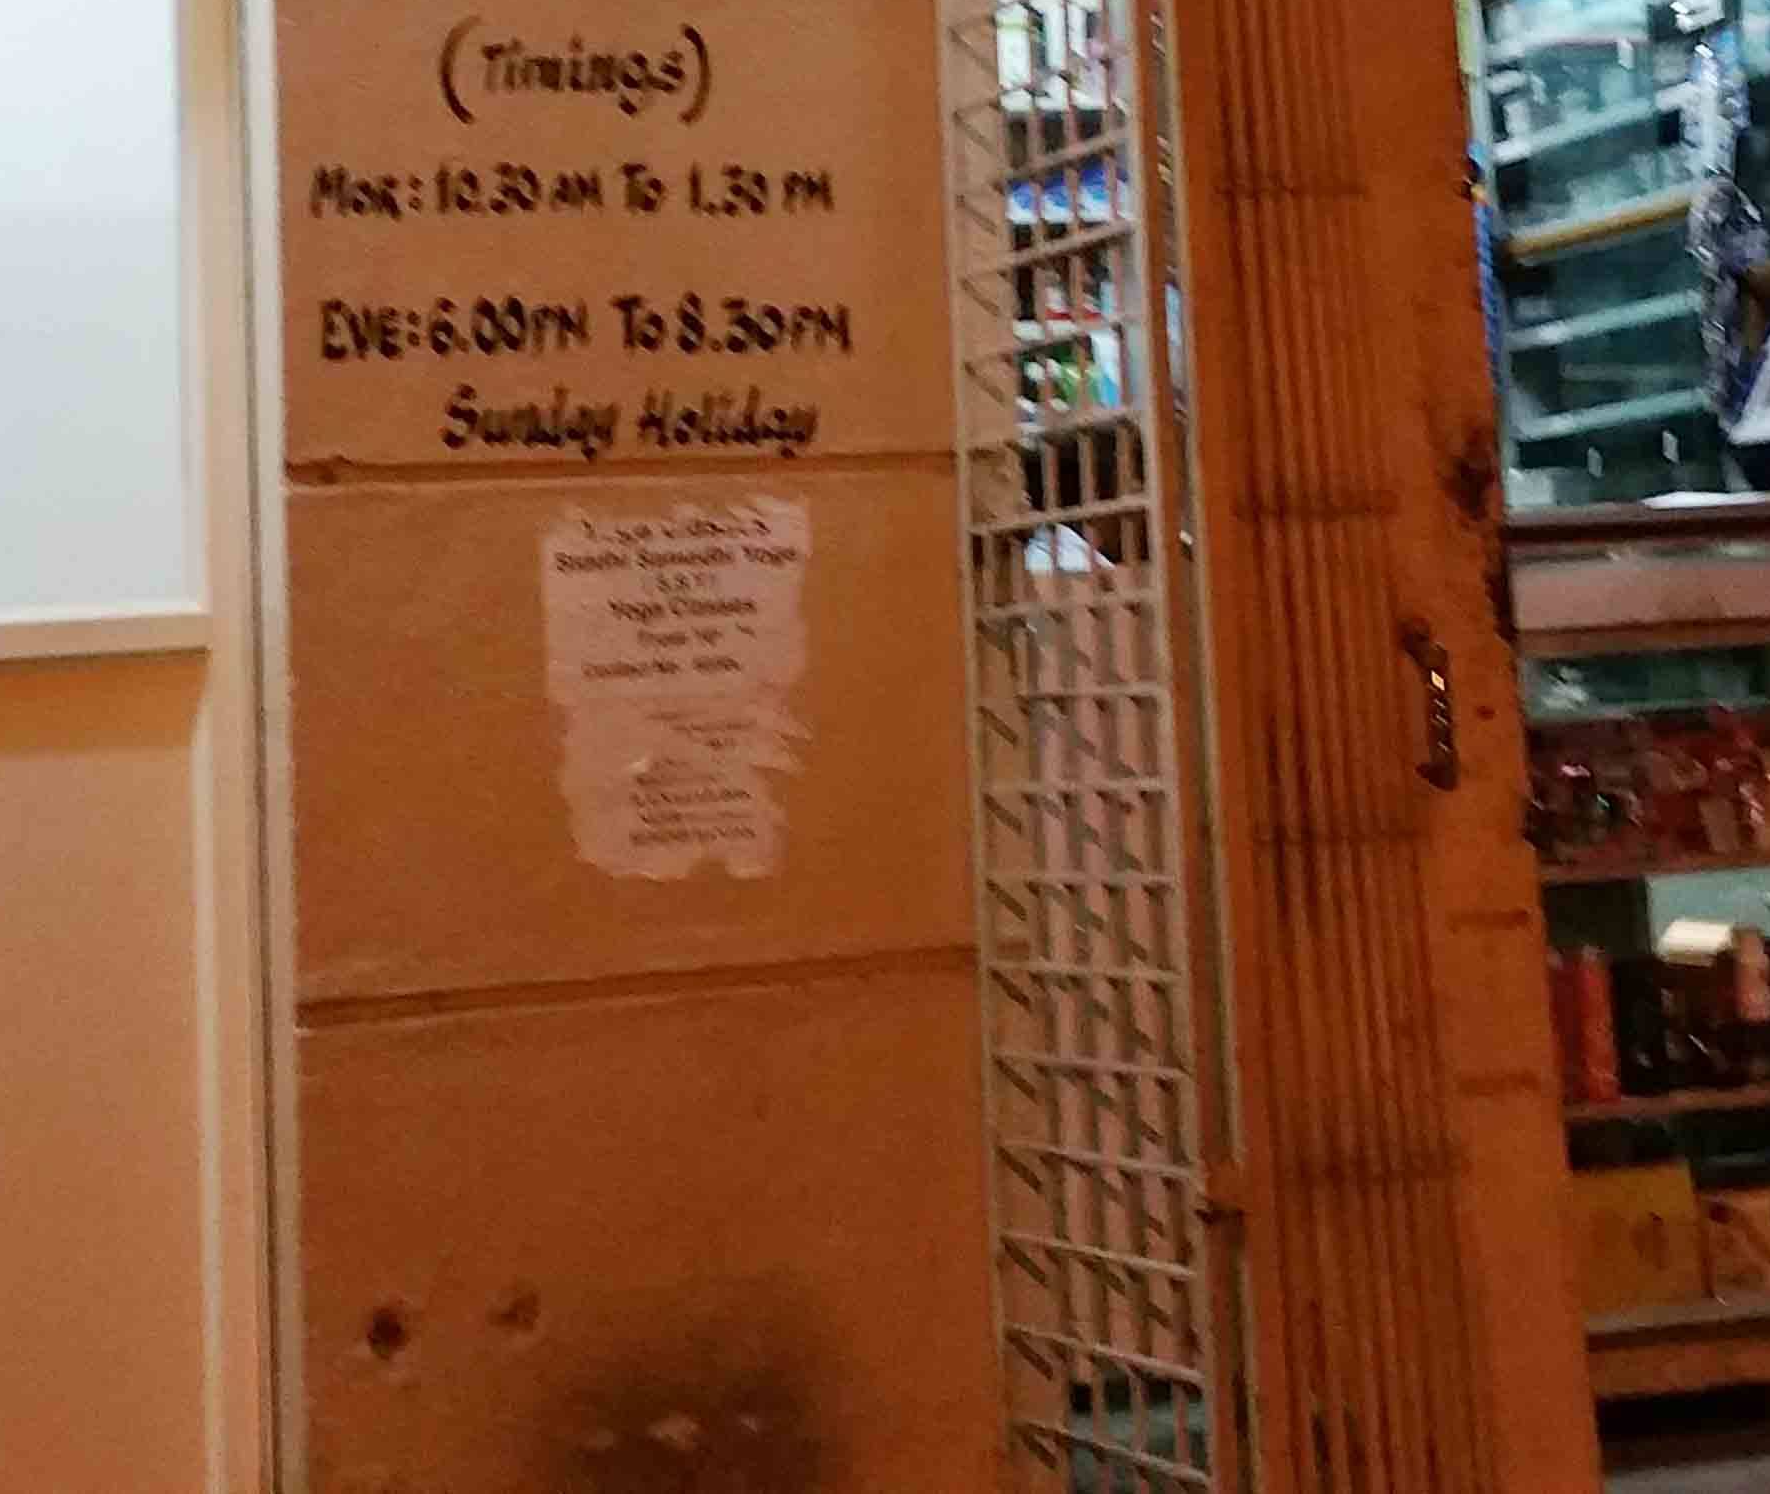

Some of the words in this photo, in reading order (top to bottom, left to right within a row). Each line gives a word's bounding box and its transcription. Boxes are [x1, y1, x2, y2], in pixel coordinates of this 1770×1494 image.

[439, 14, 711, 125] (Timings)
[435, 161, 543, 216] 10.30
[687, 163, 769, 218] 1.30
[441, 383, 619, 464] Sunday
[637, 386, 819, 459] Holiday
